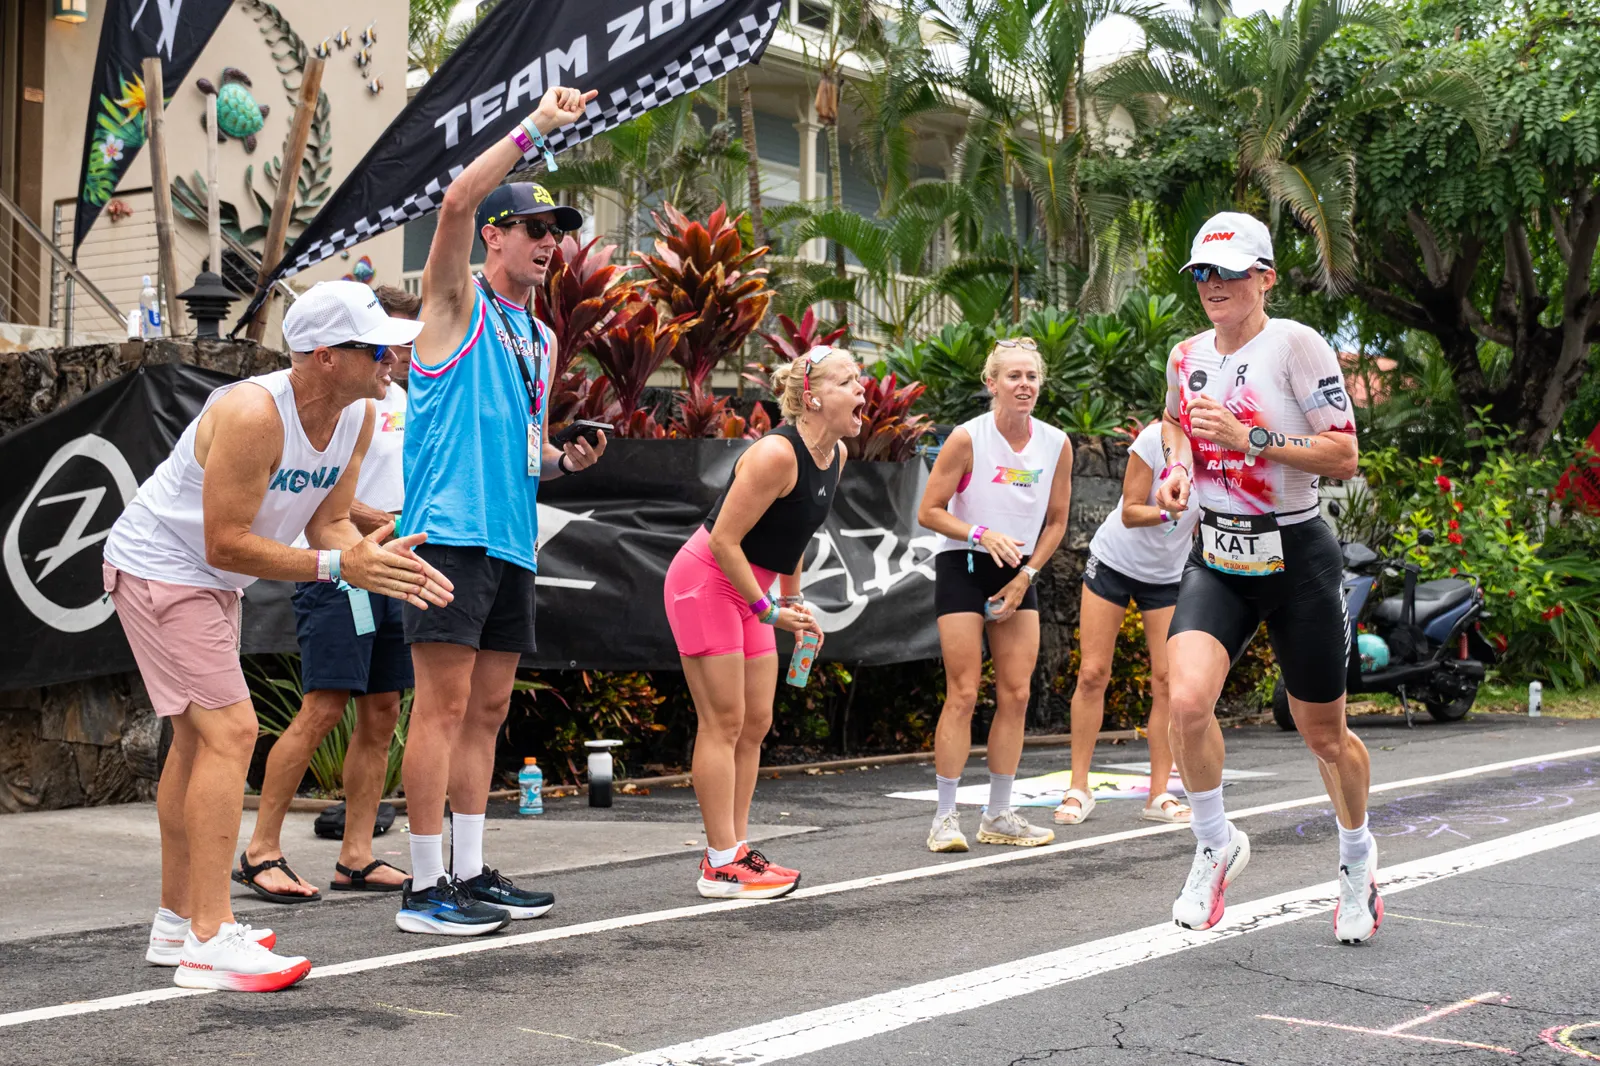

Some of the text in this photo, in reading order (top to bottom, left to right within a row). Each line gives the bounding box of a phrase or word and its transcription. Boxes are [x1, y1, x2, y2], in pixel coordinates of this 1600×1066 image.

[434, 35, 588, 149] TEAM
[1202, 232, 1235, 244] RAW
[1318, 375, 1339, 389] RAW
[1207, 459, 1245, 470] RAW
[270, 466, 340, 493] KONA
[1215, 531, 1259, 555] KAT
[715, 871, 738, 883] FILA
